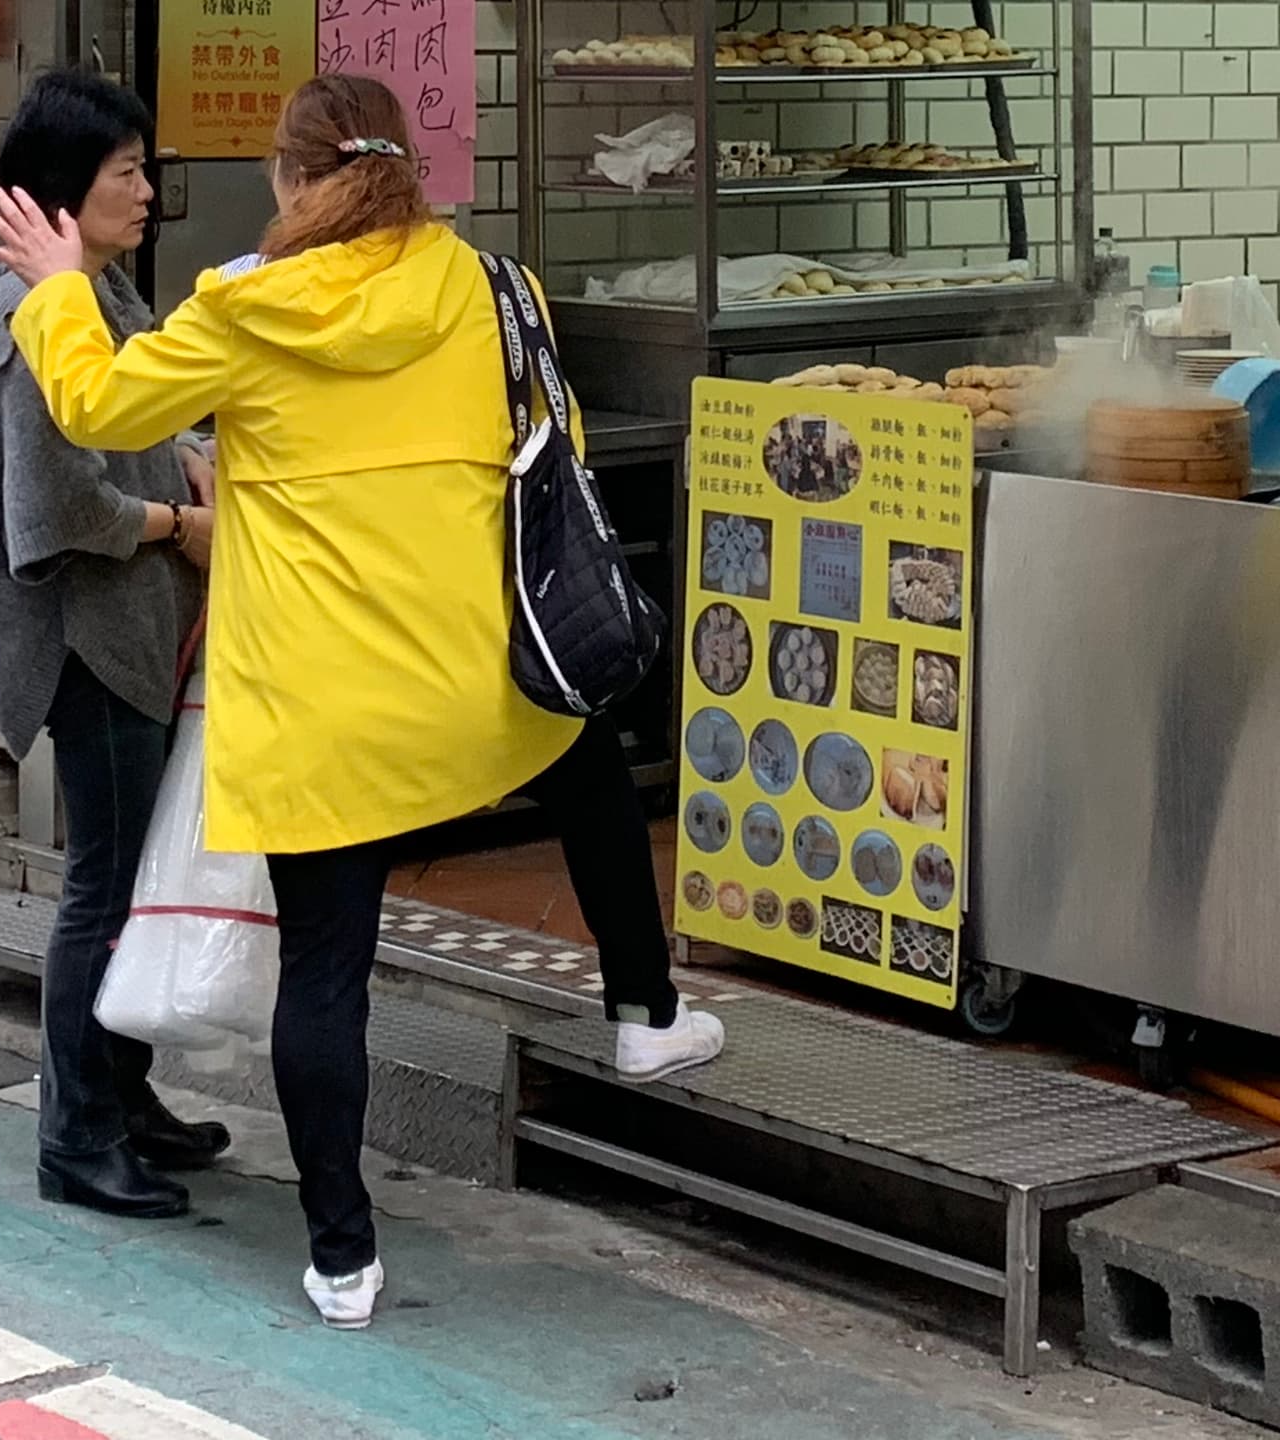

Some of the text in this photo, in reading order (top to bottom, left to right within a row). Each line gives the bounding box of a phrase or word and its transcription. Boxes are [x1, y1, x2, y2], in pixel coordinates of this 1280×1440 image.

[191, 44, 281, 67] 禁帶外食
[211, 70, 251, 81] Outside
[253, 70, 280, 81] Food
